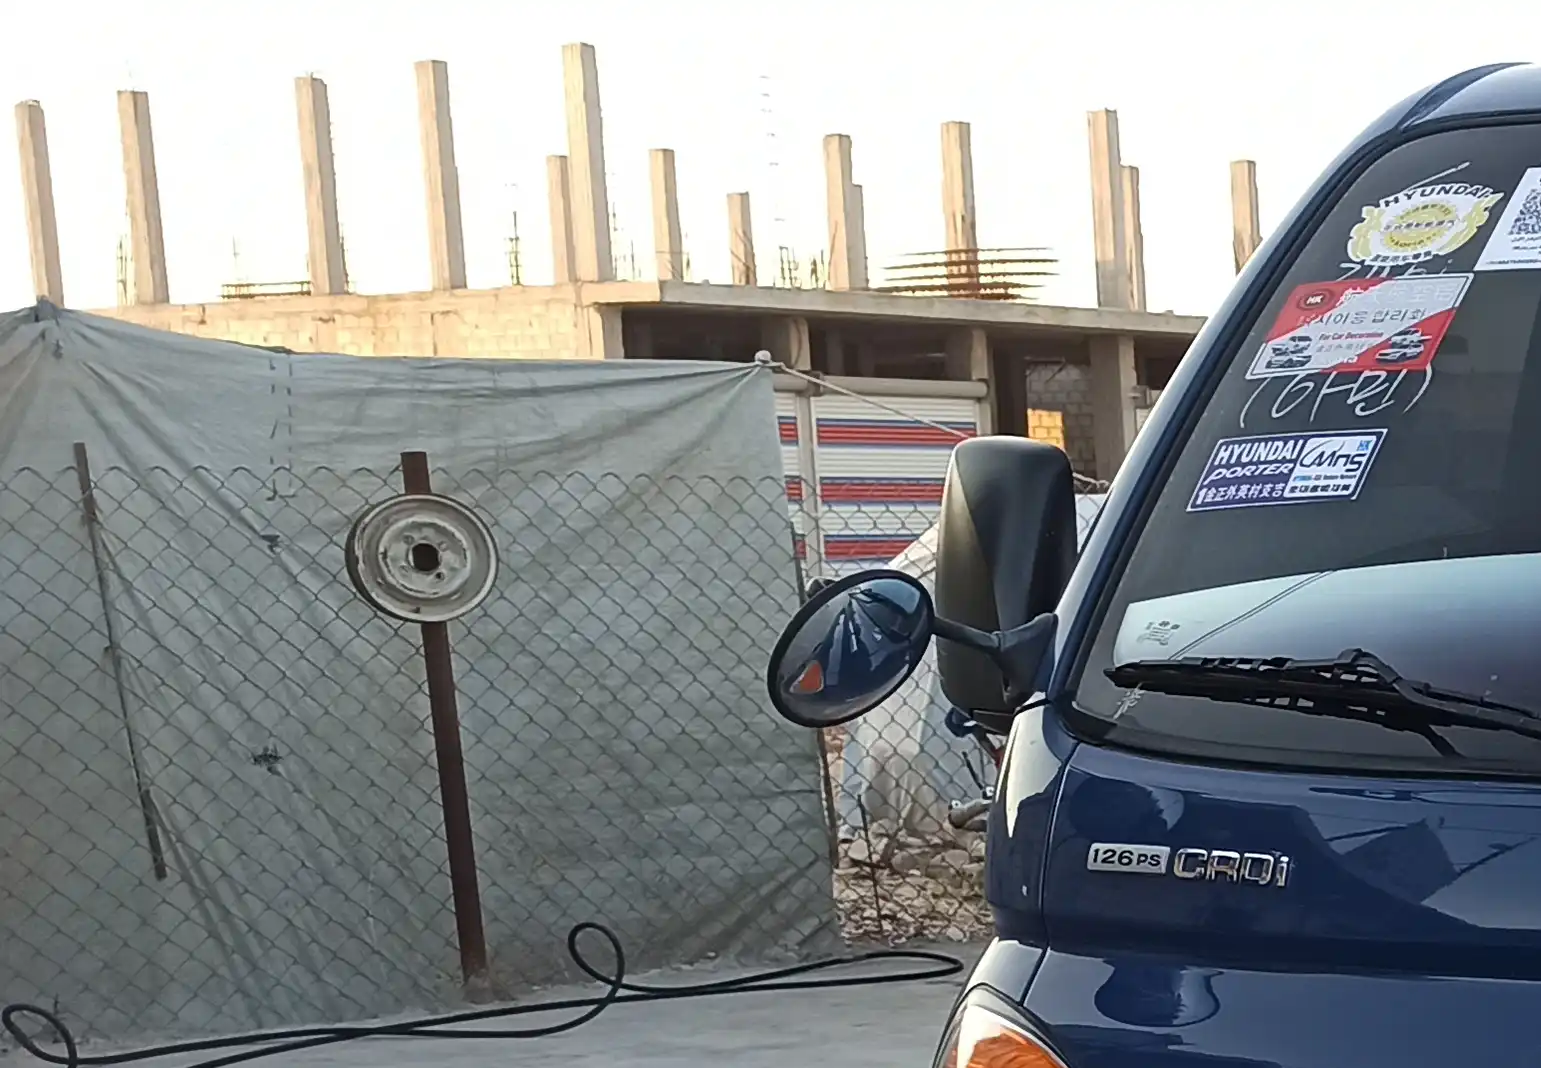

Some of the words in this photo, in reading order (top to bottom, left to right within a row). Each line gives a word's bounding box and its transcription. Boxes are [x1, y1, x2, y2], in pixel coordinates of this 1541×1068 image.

[1384, 184, 1494, 208] HYUNDAI
[1214, 438, 1305, 467] HYUNDAI
[1202, 462, 1295, 486] PORTER
[1173, 848, 1291, 887] CRDi
